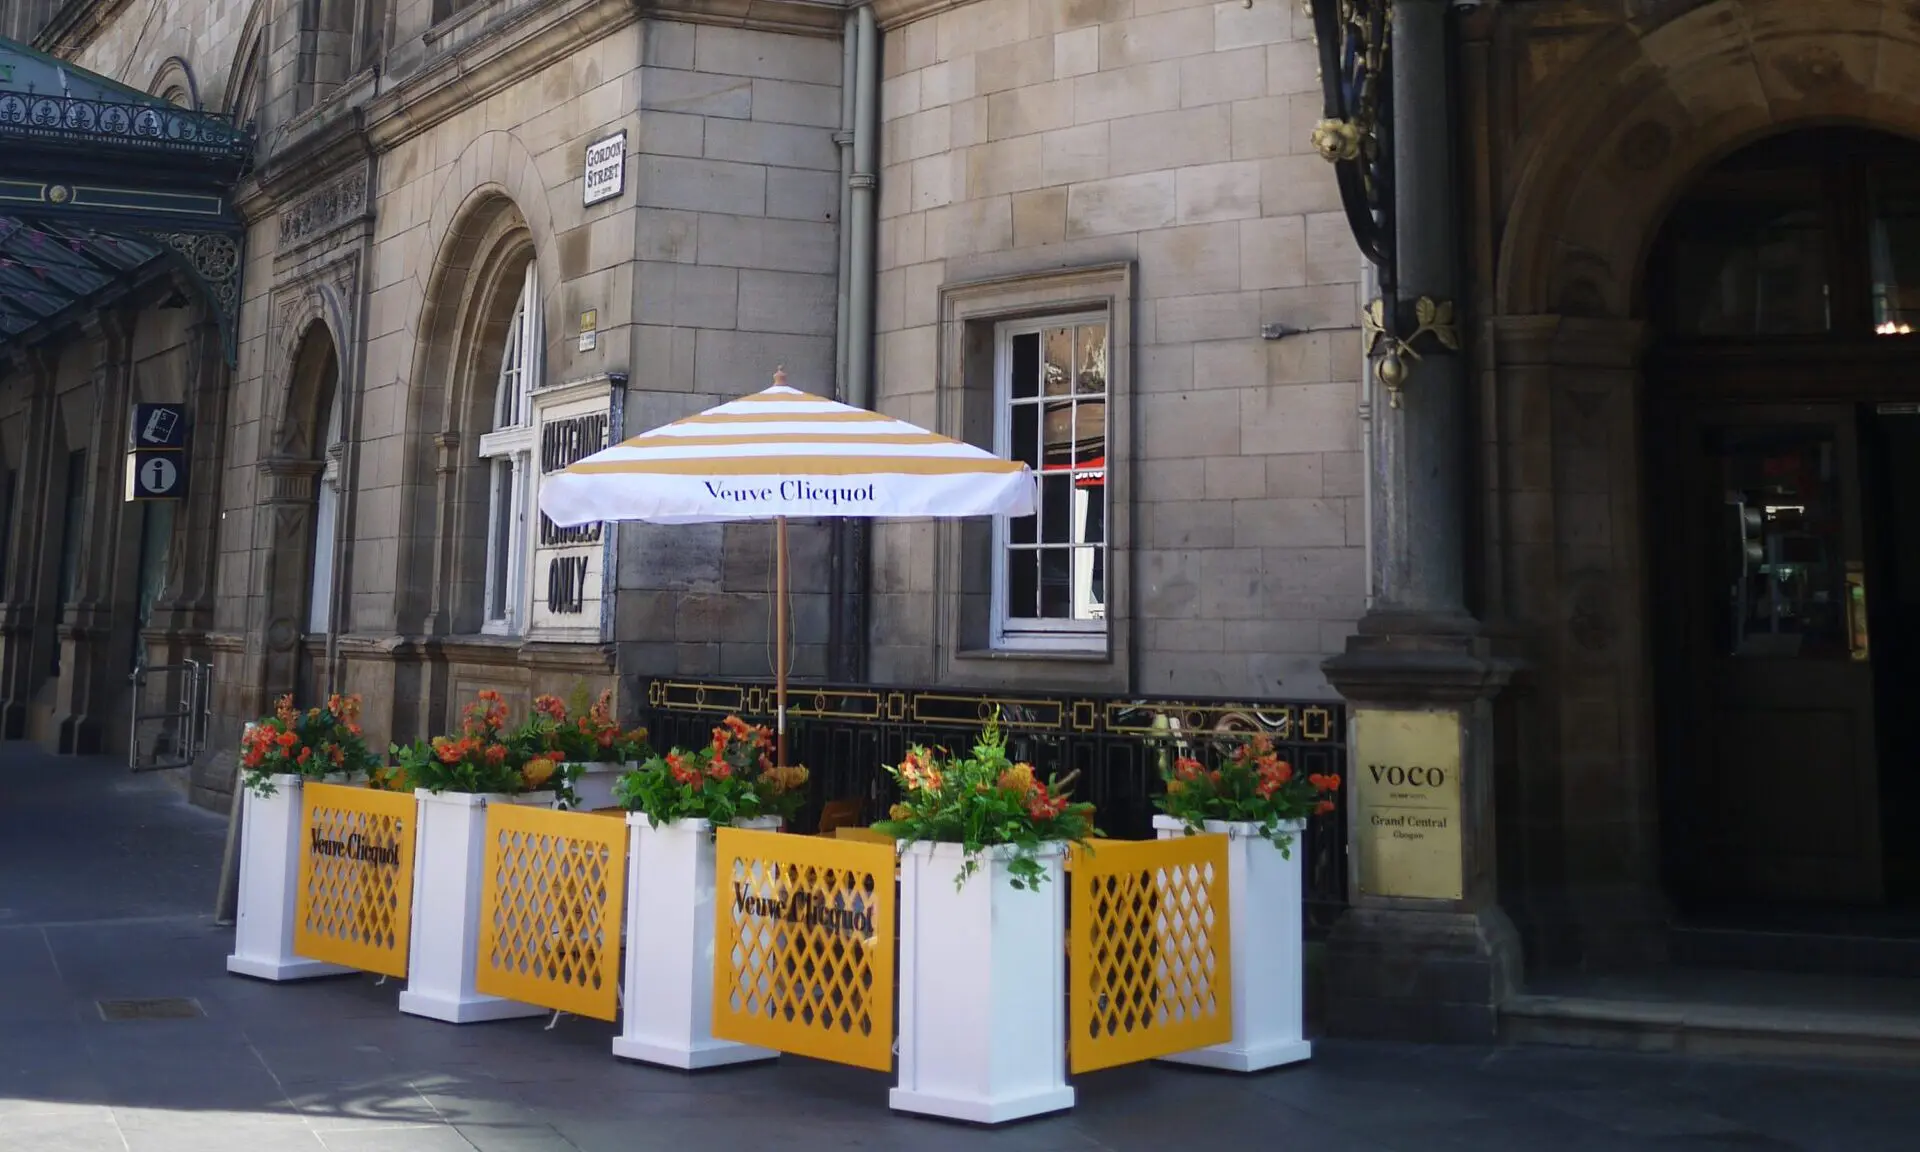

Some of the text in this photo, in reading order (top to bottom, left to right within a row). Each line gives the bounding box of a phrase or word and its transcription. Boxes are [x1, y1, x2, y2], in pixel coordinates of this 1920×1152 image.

[588, 142, 622, 167] GORDON
[588, 164, 619, 188] STREET
[703, 480, 876, 505] Veuve Clicquot
[548, 555, 588, 615] ONLY
[1371, 815, 1447, 829] Grand Central
[312, 825, 400, 869] Veuve Clicquot
[734, 881, 874, 936] Veuve Clicquot
